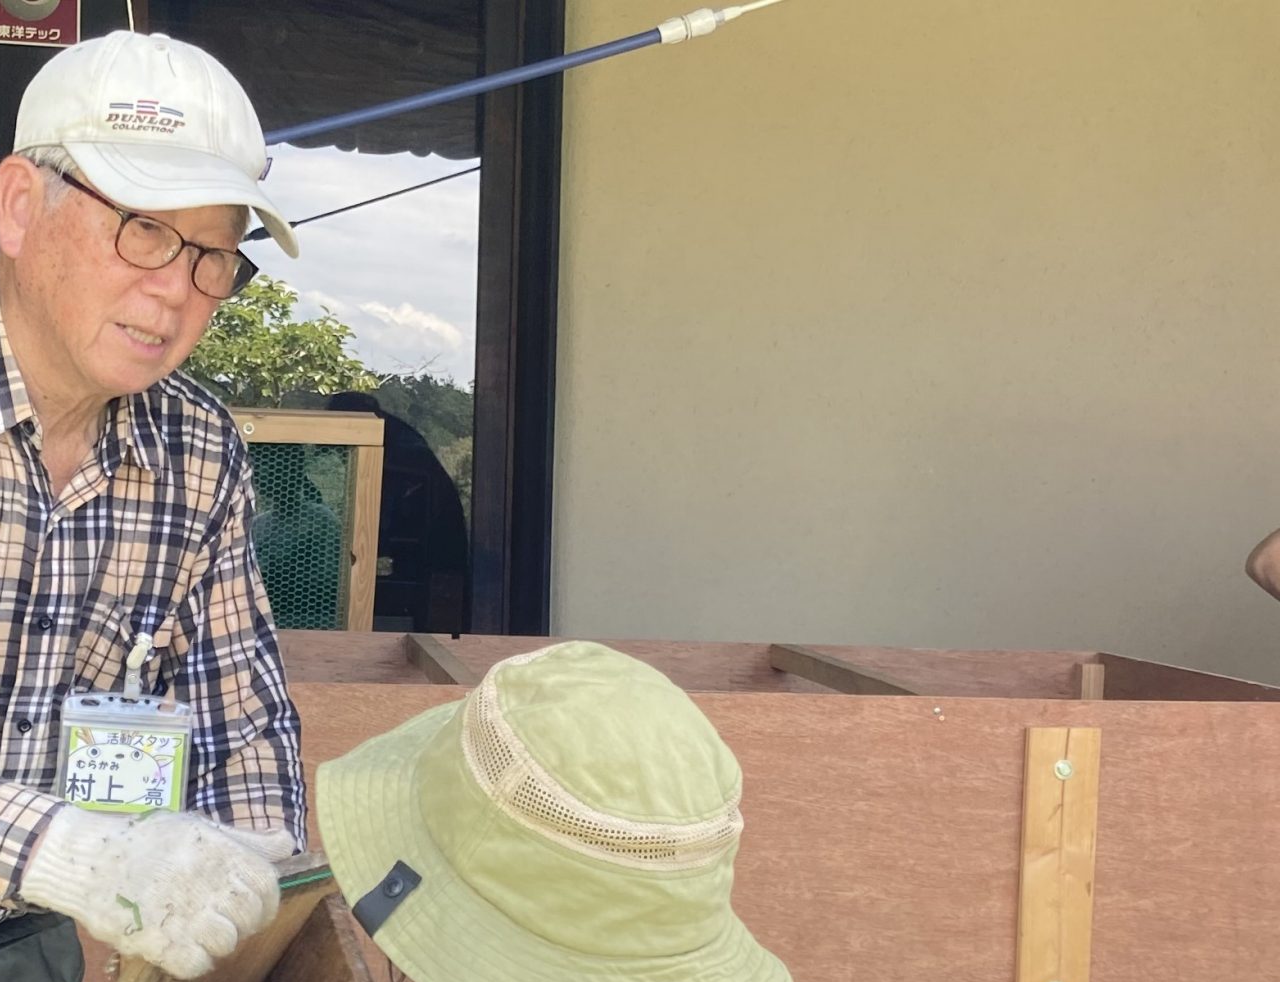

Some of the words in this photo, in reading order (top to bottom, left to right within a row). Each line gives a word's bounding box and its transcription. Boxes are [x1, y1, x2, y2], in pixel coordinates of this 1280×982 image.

[105, 113, 186, 129] DUNLOP
[112, 123, 175, 135] COLLECTION
[107, 732, 183, 749] 活動スタッフ
[76, 760, 120, 771] むらかみ
[66, 773, 125, 804] 村上
[144, 787, 165, 807] 亮
